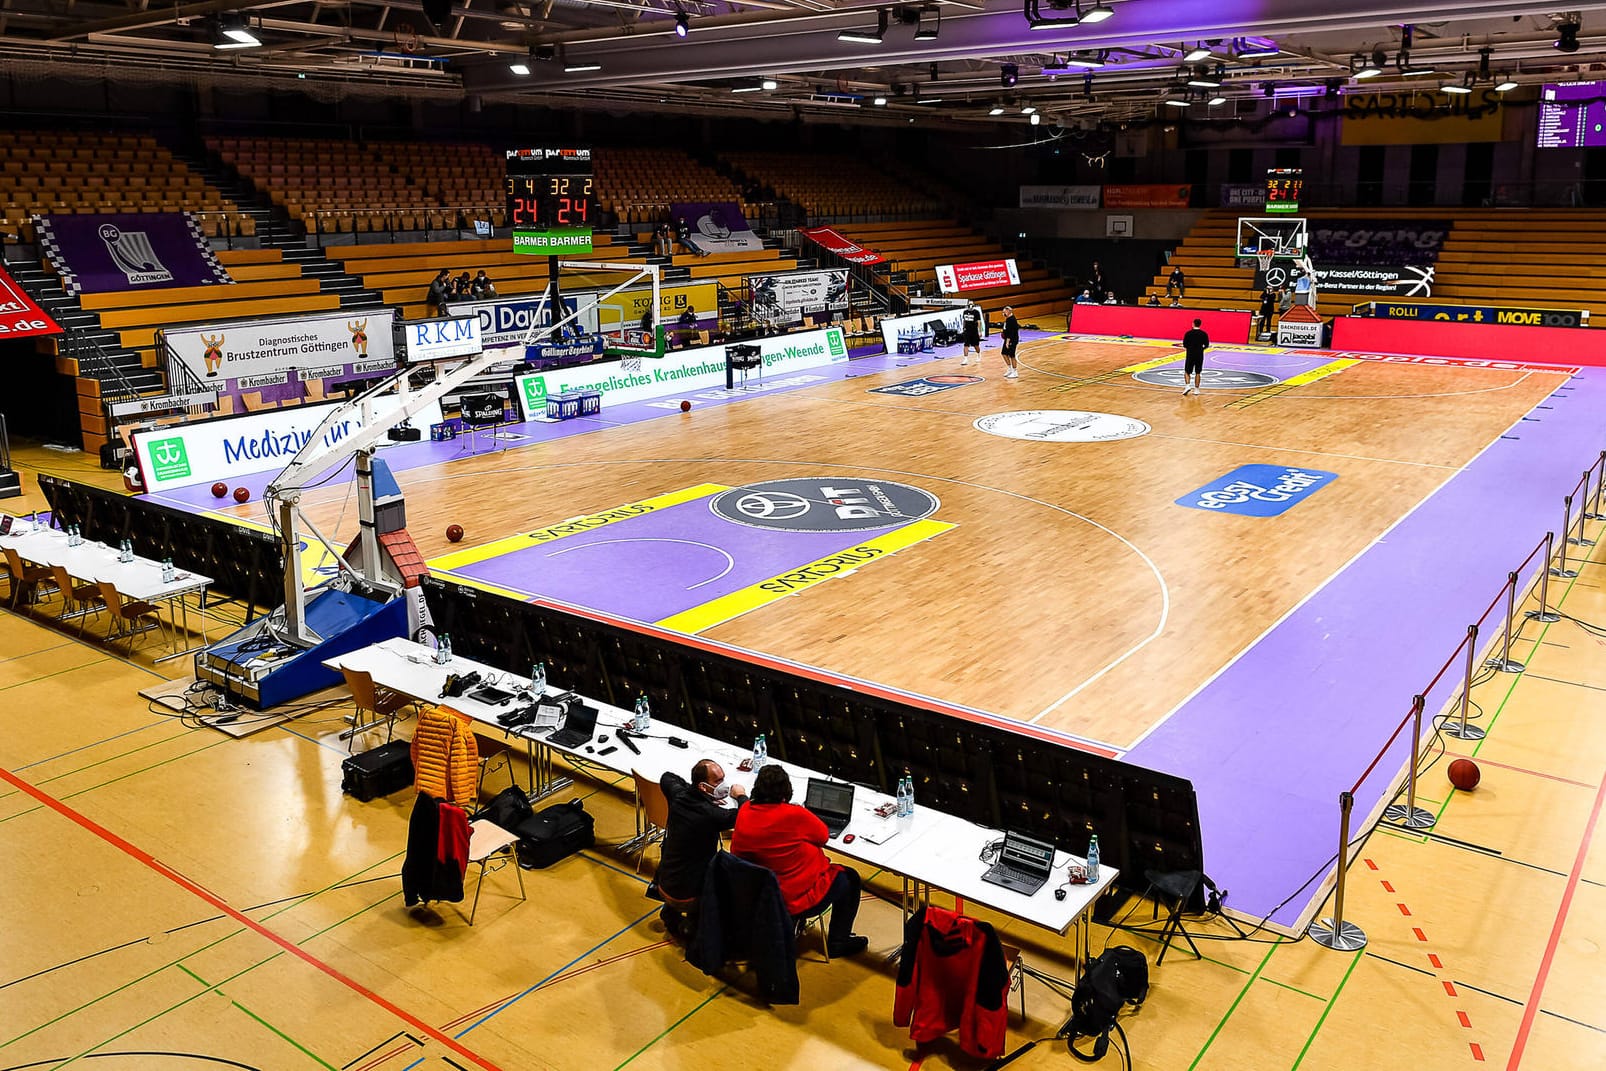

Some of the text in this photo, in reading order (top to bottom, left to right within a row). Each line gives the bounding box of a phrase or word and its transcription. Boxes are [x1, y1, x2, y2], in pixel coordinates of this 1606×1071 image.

[526, 179, 534, 195] 4
[550, 179, 569, 195] 32
[584, 179, 592, 195] 2
[514, 199, 586, 223] 24 24
[103, 230, 117, 238] BG
[514, 236, 592, 246] BARMER BARMER
[130, 273, 171, 282] GÖTTINGEN
[1329, 269, 1399, 280] Kassel/Göttingen
[1388, 306, 1418, 317] ROLLI
[1497, 311, 1541, 325] MOVE
[1544, 313, 1575, 327] 100
[416, 320, 474, 345] RKM
[258, 333, 318, 347] Diagnostisches
[227, 339, 349, 362] Brustzentrum Göttingen
[307, 366, 343, 380] Krombacher
[362, 361, 395, 373] Krombacher
[654, 360, 728, 383] Krankenhaus
[249, 374, 288, 388] Krombacher
[150, 397, 191, 410] Krombacher
[475, 408, 503, 418] SPALDING
[223, 425, 311, 464] Medizin
[528, 502, 655, 541] SARTORIUS
[760, 546, 883, 594] SARTORIUS
